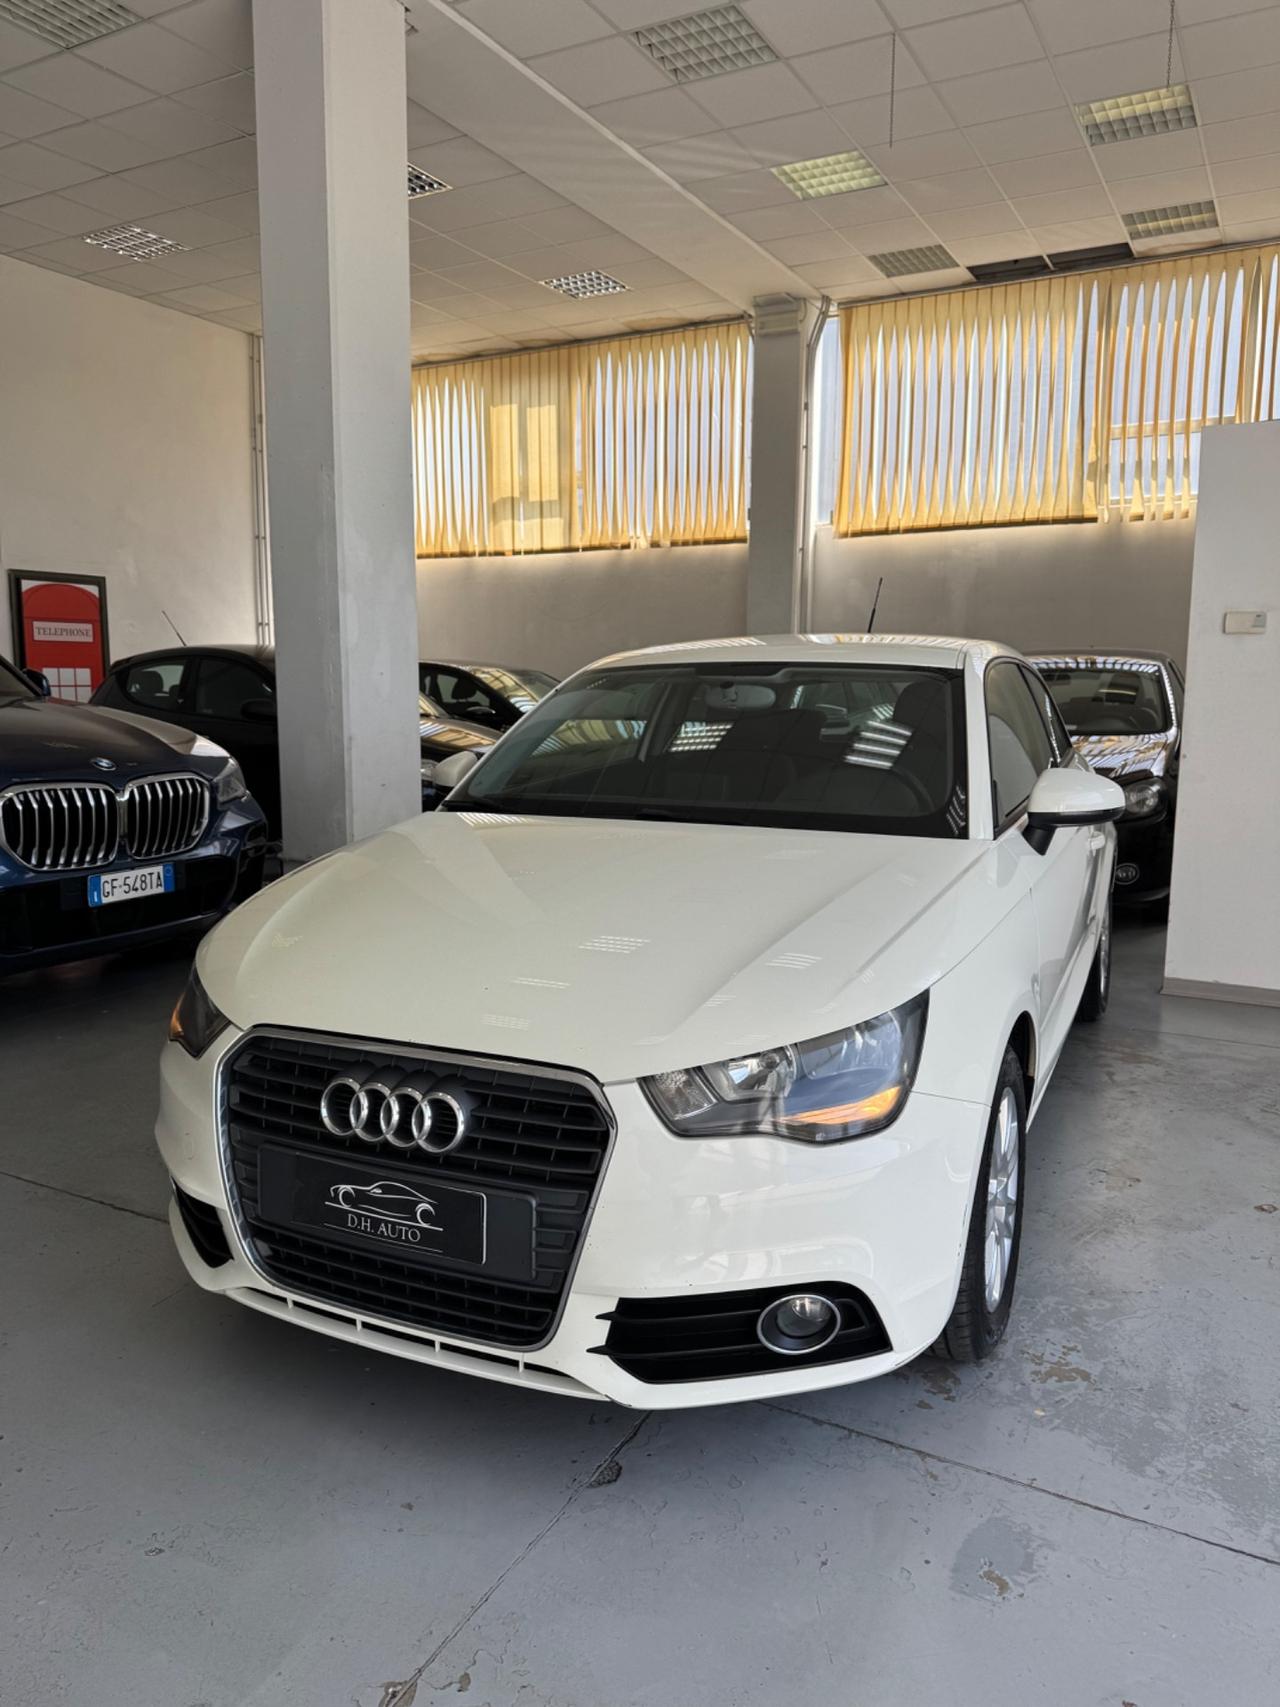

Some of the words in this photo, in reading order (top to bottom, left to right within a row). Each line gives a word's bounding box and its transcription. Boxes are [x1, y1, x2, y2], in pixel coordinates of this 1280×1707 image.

[35, 626, 91, 638] TELEPHONE
[347, 1213, 375, 1233] D.H.
[377, 1222, 421, 1242] AUTO
